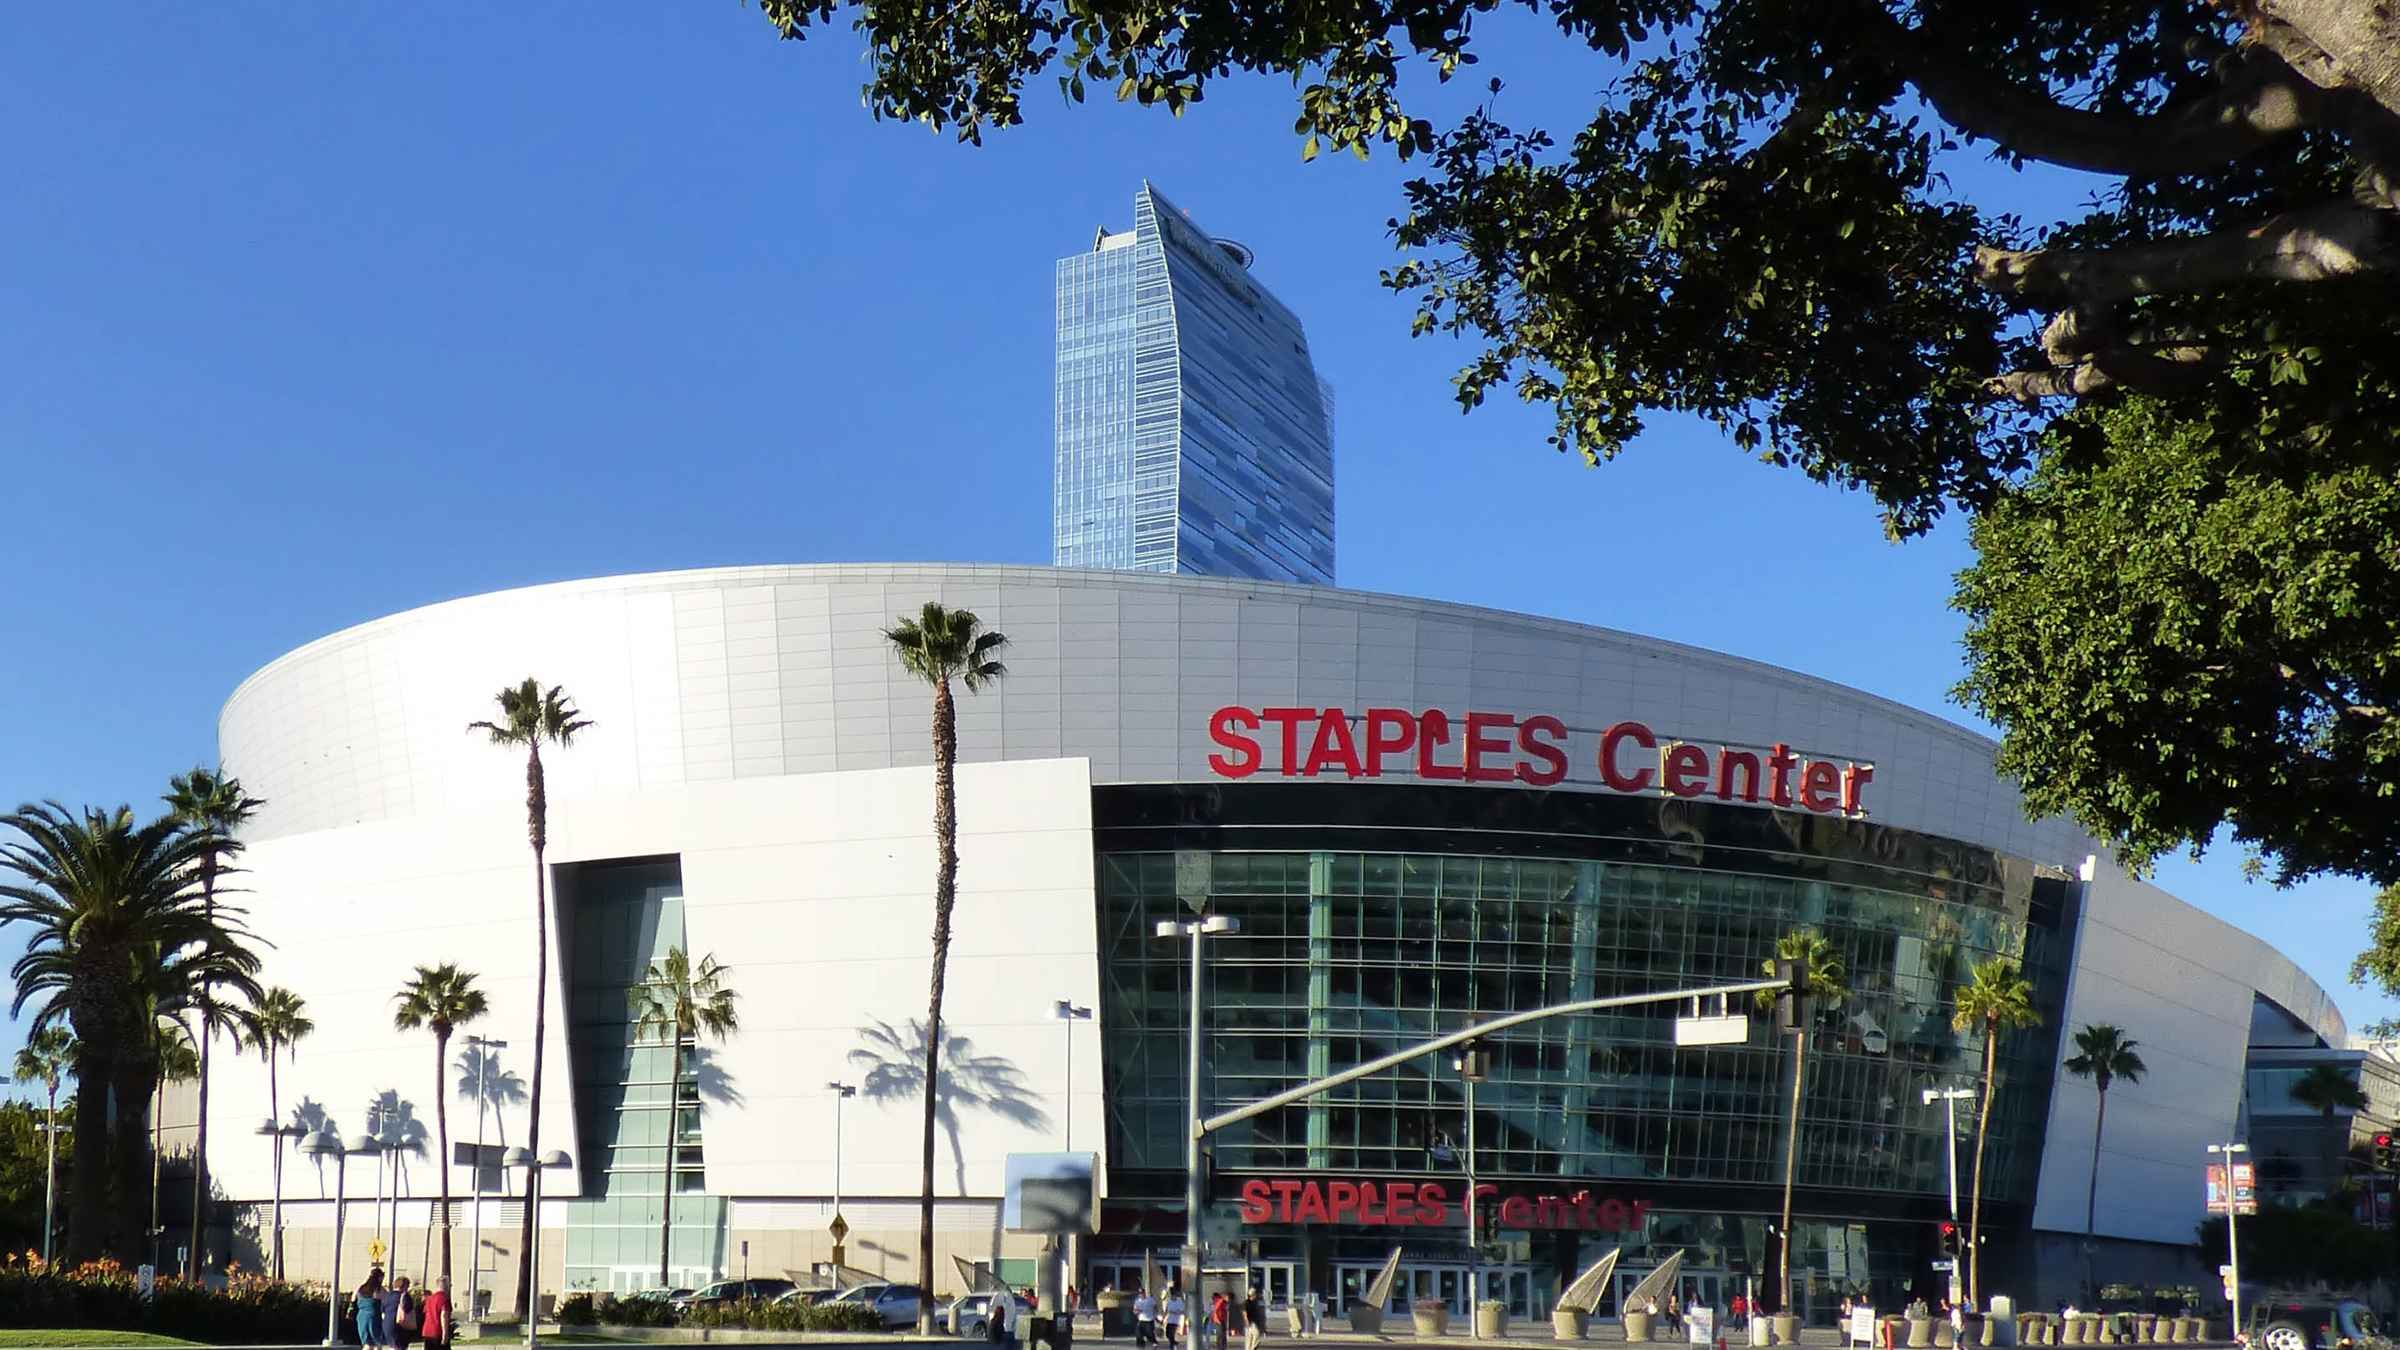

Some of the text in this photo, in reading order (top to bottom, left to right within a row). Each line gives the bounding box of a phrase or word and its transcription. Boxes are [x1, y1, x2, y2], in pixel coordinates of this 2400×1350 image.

[1209, 706, 1874, 817] STAPLES Center
[1242, 1179, 1653, 1230] STAPLES Center
